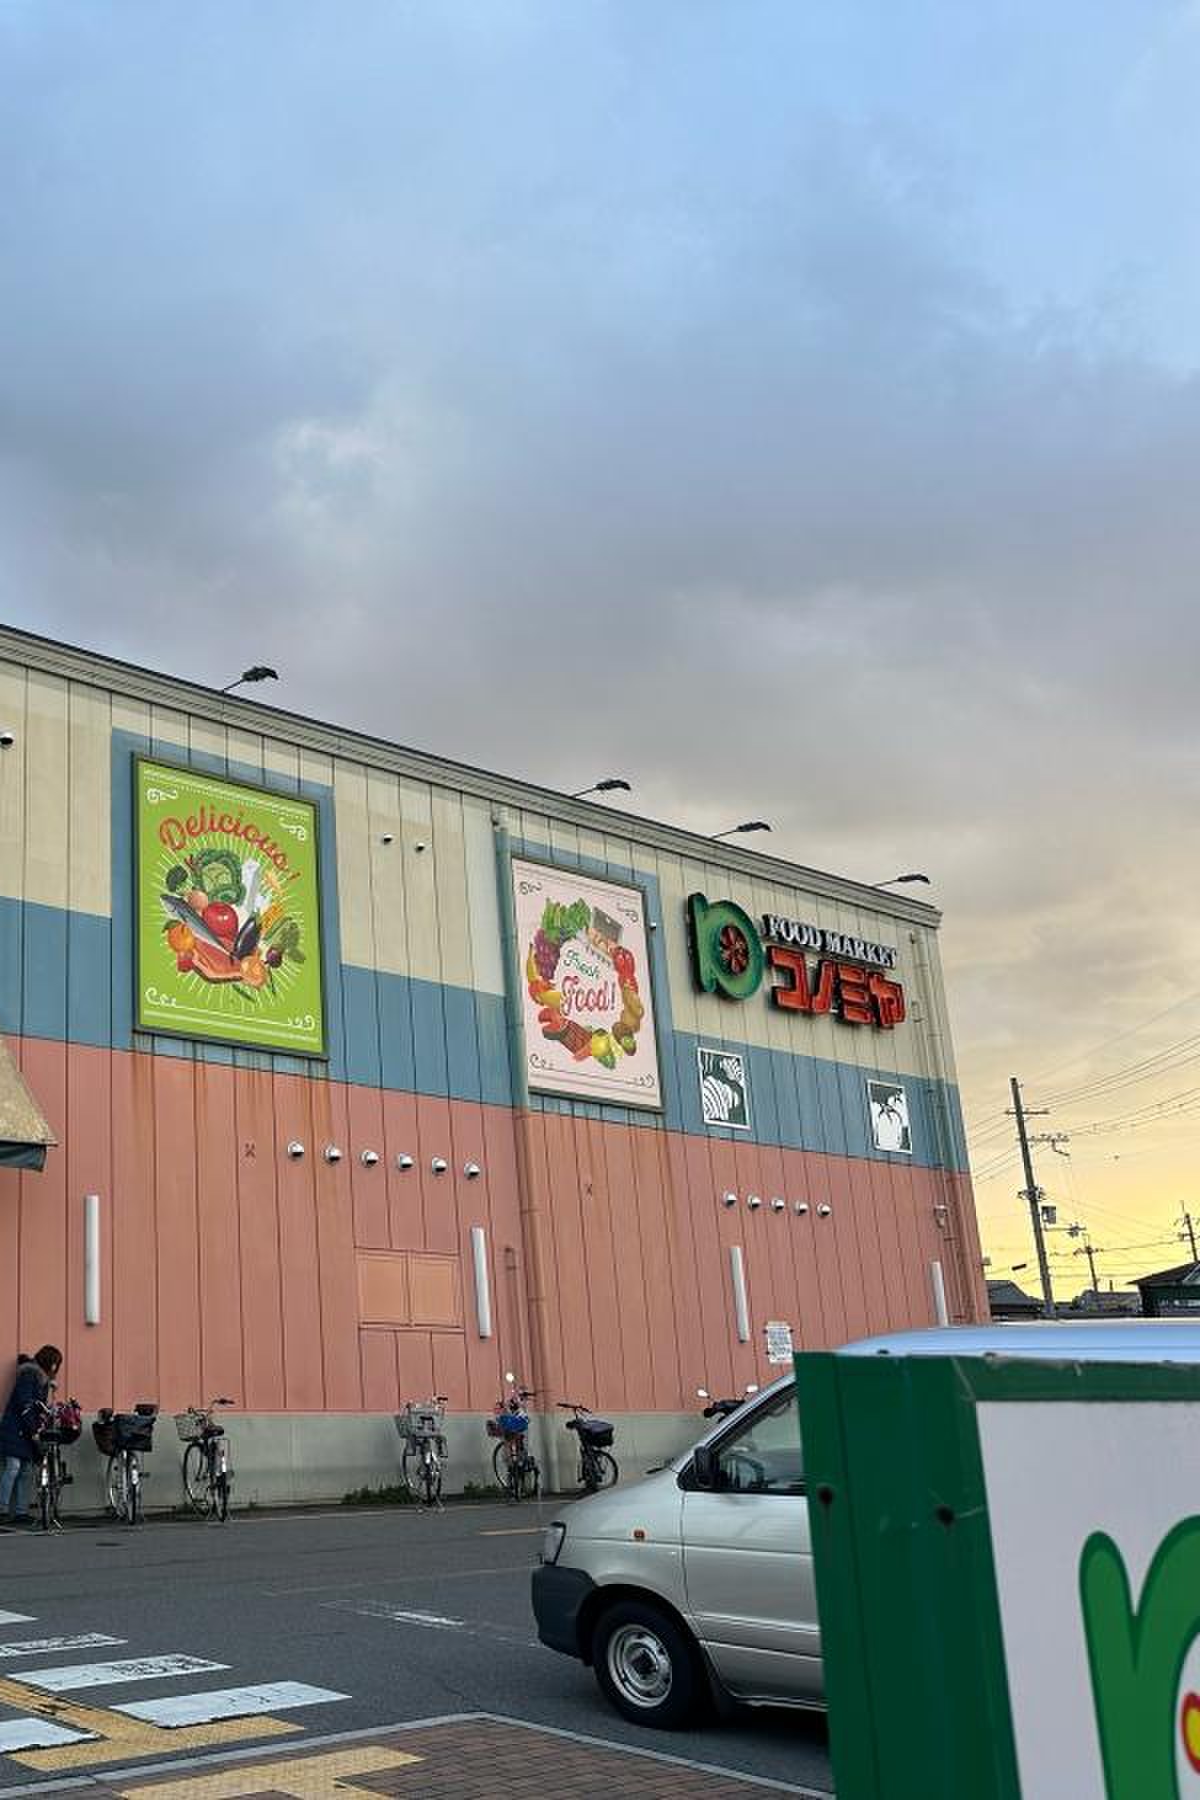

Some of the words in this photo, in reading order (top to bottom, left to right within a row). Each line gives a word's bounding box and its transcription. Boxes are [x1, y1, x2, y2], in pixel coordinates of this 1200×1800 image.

[768, 917, 822, 953] FOOD
[825, 930, 897, 970] MARKET
[769, 944, 905, 1026] コノミヤ
